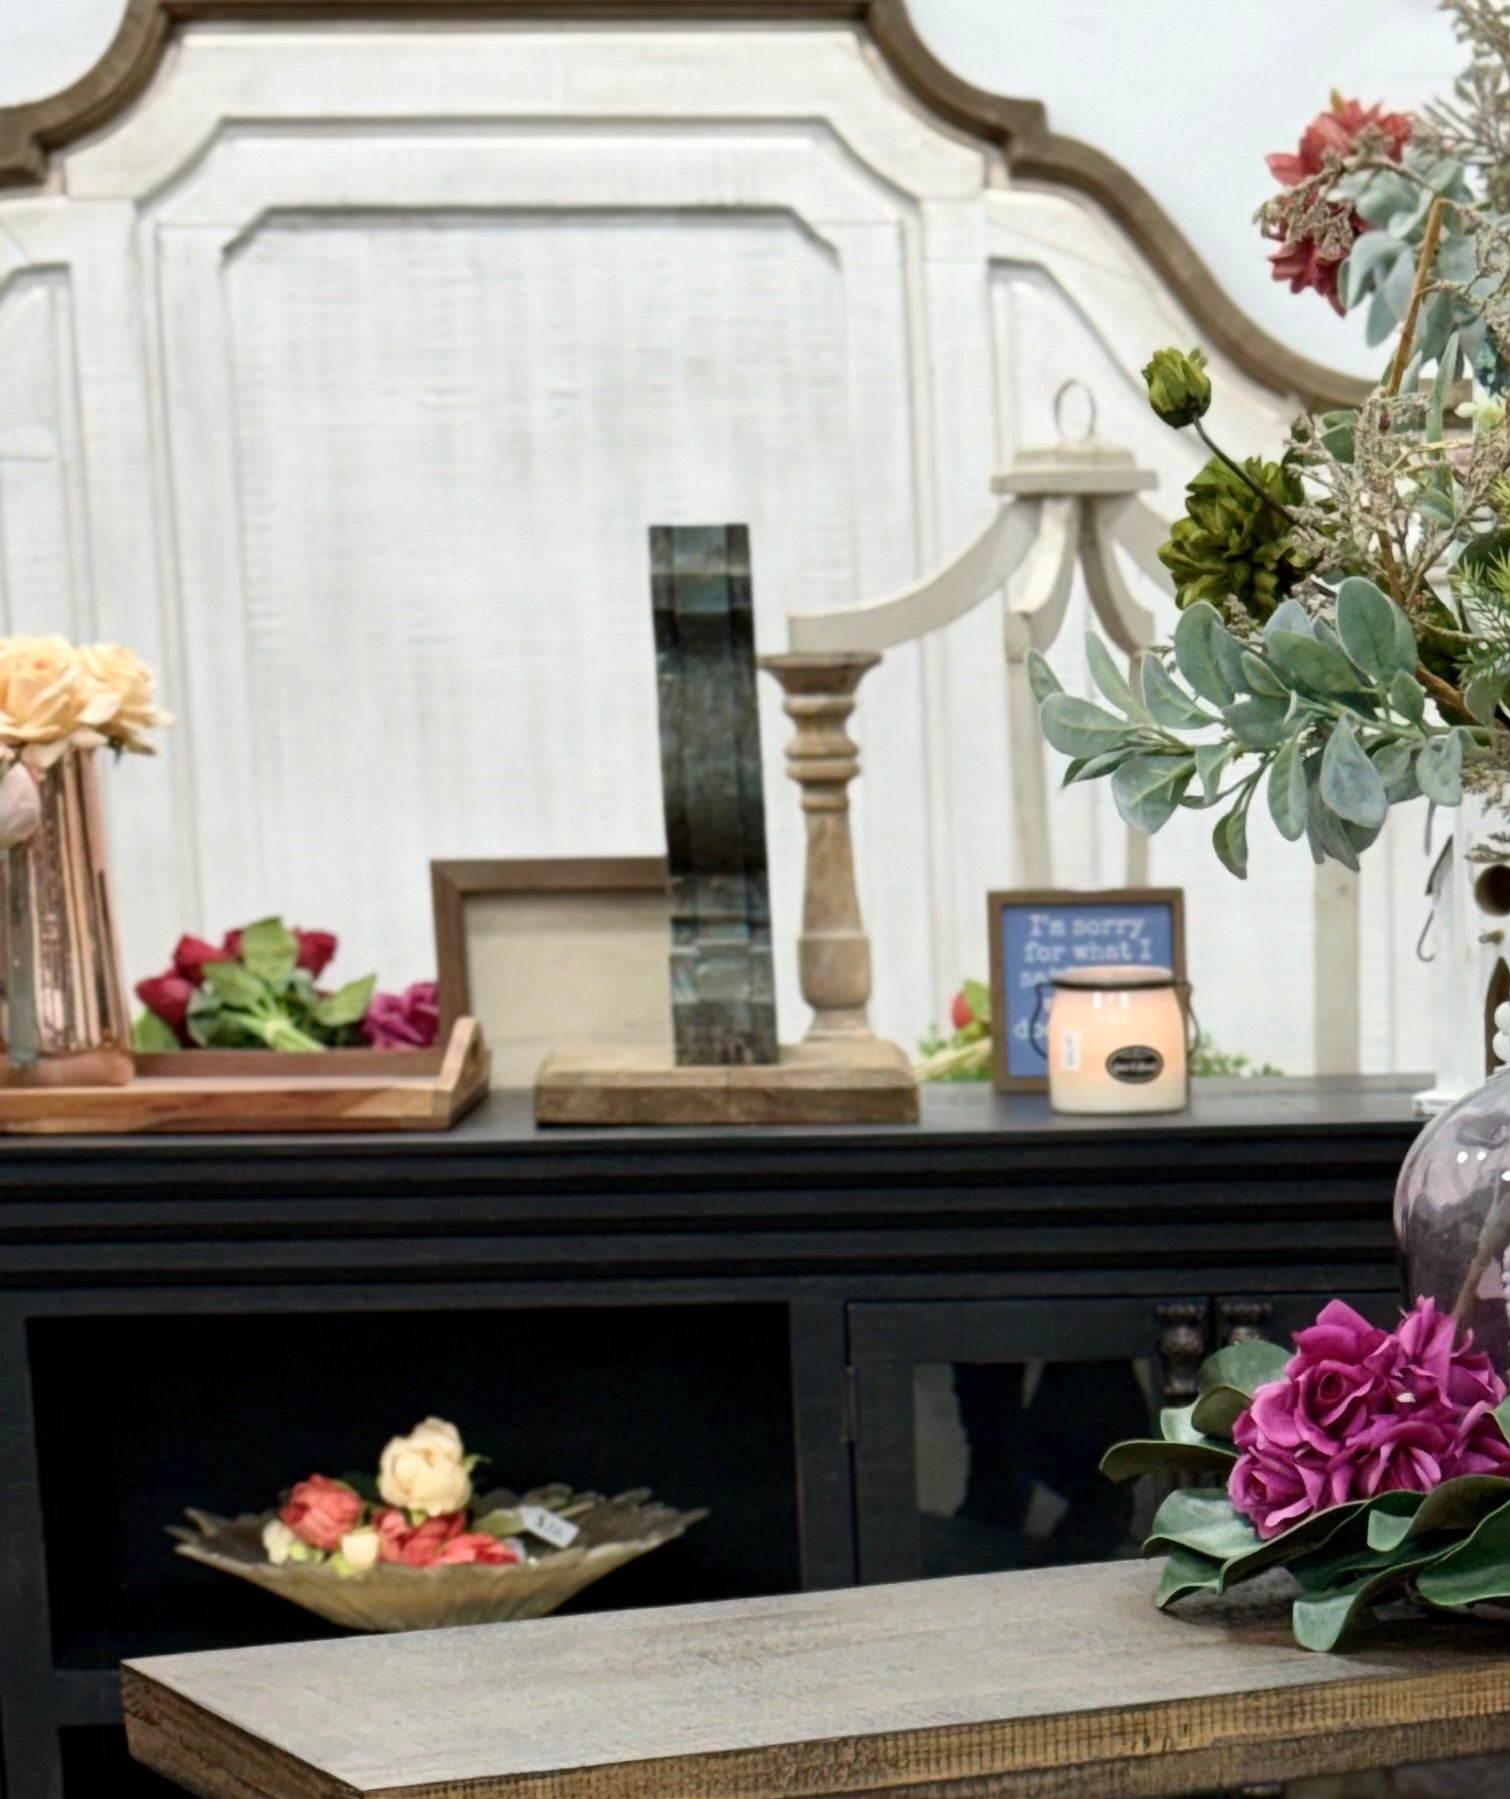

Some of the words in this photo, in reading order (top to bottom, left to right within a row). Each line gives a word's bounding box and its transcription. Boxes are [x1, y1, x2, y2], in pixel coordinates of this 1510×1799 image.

[1029, 914, 1066, 937] I'm
[1072, 918, 1145, 939] sorry
[1024, 941, 1066, 962] for
[1072, 939, 1132, 960] what
[1140, 938, 1152, 960] I
